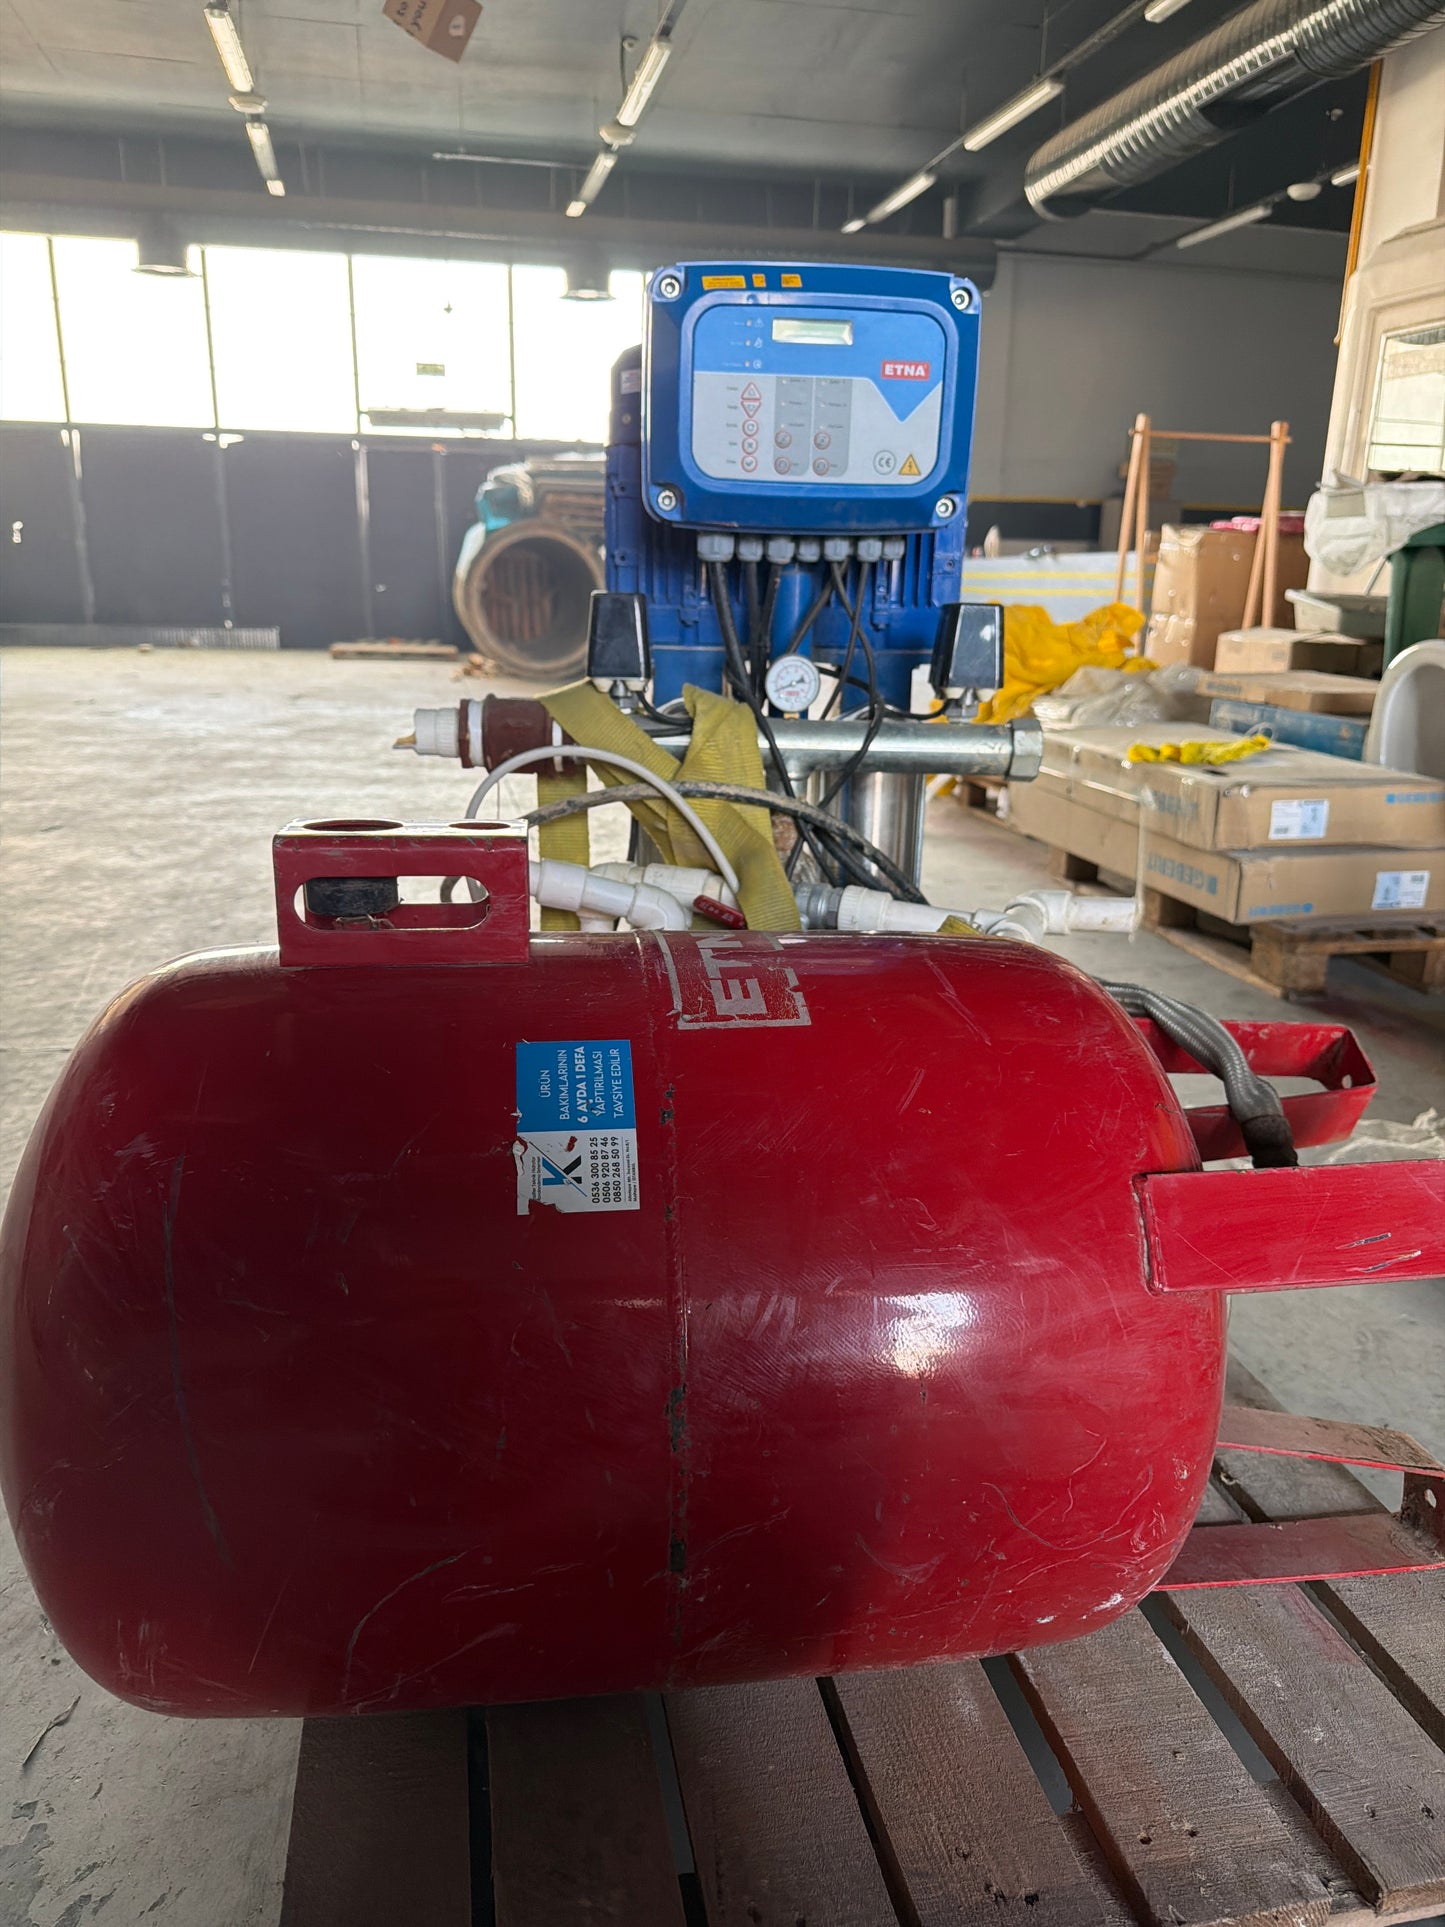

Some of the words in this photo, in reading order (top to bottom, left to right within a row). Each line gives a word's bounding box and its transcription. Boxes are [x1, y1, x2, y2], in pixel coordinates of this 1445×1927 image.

[884, 363, 926, 377] ETNA
[574, 1045, 586, 1072] DEFA
[608, 1048, 622, 1077] EDİLİR
[540, 1069, 551, 1098] ÜRÜN
[557, 1049, 570, 1120] BAKIMLARININ
[591, 1051, 605, 1116] YAPTIRILMASI
[576, 1081, 588, 1112] AYDA
[610, 1078, 624, 1119] TAVSİYE
[577, 1115, 588, 1124] 6
[589, 1136, 598, 1147] 25
[600, 1136, 608, 1147] 46
[610, 1136, 618, 1147] 99
[590, 1149, 599, 1160] 85
[600, 1149, 609, 1160] 87
[611, 1148, 619, 1159] 50
[590, 1162, 599, 1178] 300
[601, 1162, 610, 1178] 920
[612, 1161, 620, 1178] 268
[591, 1181, 600, 1203] 0536
[602, 1181, 611, 1203] 0506
[612, 1180, 621, 1203] 0850
